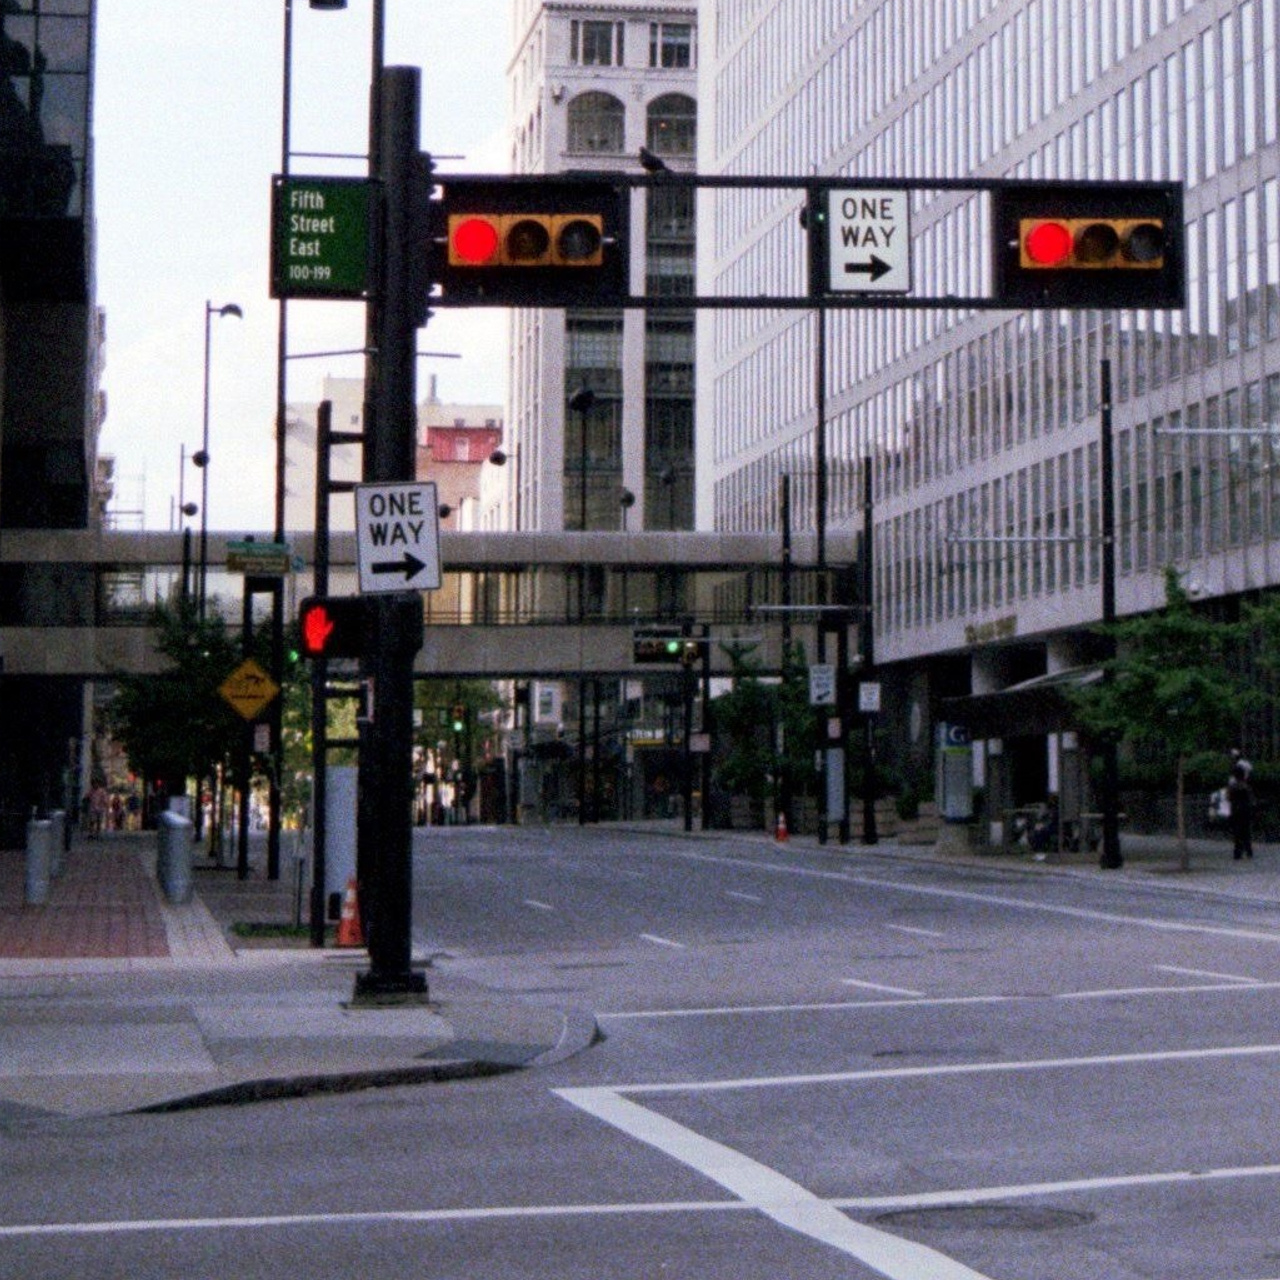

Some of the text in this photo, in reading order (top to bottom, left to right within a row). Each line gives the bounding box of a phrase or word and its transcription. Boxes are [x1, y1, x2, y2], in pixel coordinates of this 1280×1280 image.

[290, 190, 325, 209] Fifth
[841, 198, 894, 220] ONE
[290, 214, 335, 233] Street
[289, 237, 321, 256] East
[841, 225, 896, 248] WAY
[289, 265, 331, 281] 100-199
[369, 492, 423, 517] ONE
[369, 521, 424, 546] WAY
